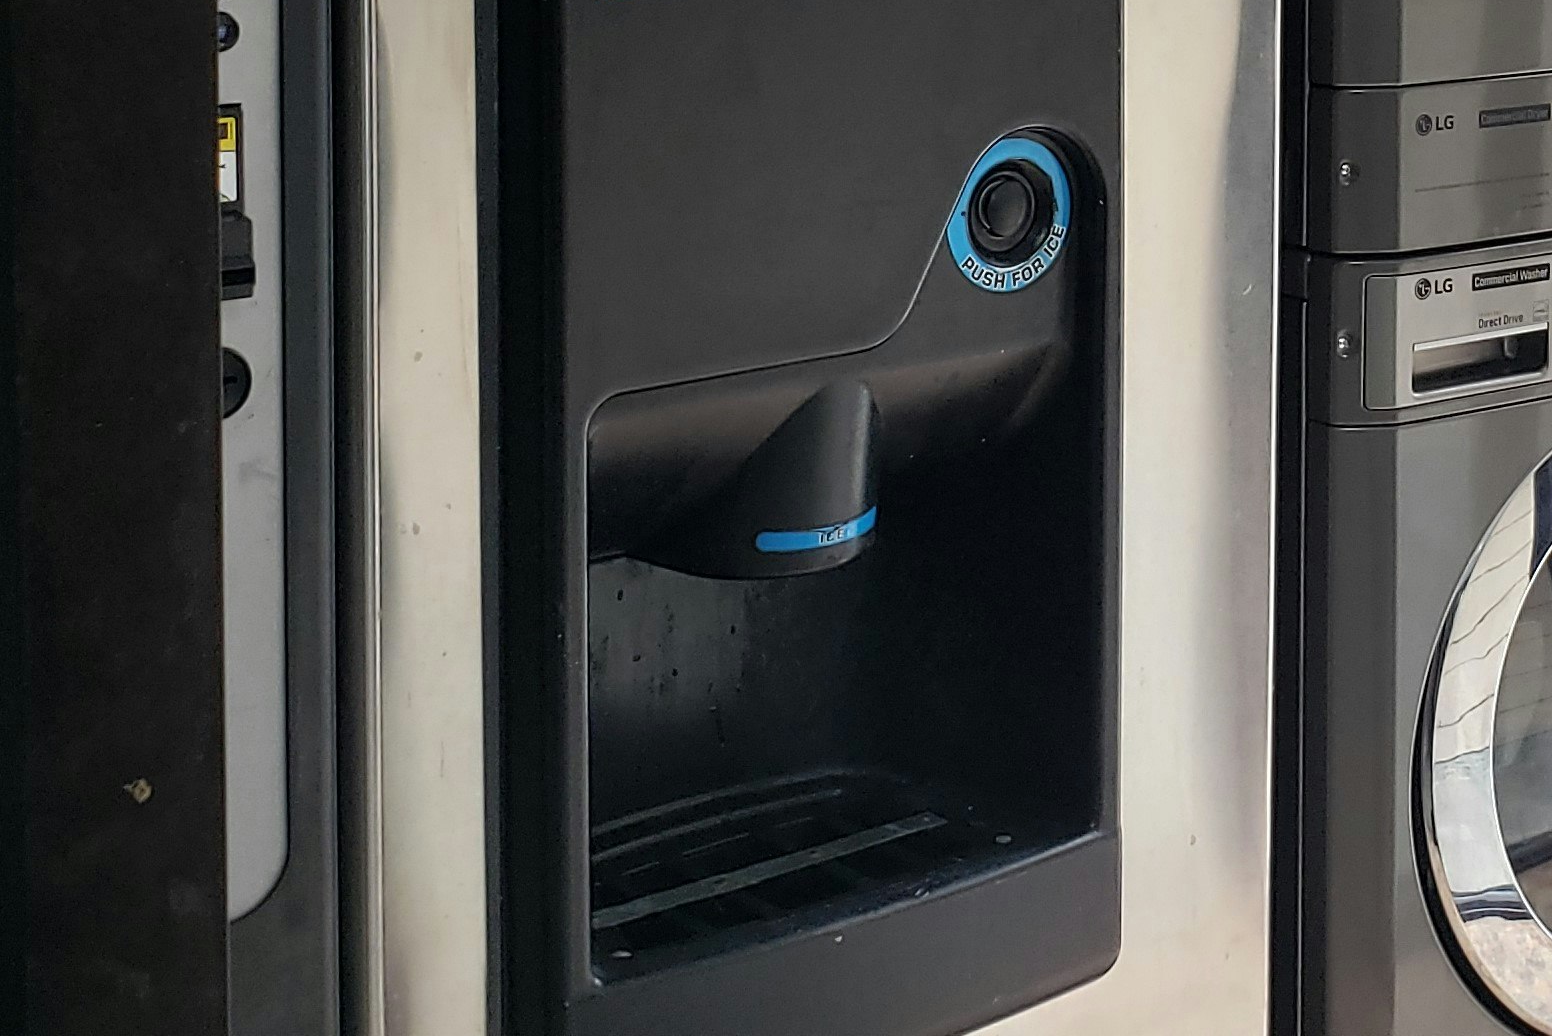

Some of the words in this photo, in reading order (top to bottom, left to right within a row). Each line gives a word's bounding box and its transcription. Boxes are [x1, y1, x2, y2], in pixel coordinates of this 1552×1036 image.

[961, 254, 1006, 289] PUSH
[1011, 257, 1045, 287] FOR
[1043, 224, 1065, 258] ICE
[1474, 272, 1518, 287] Commercial
[1519, 267, 1548, 280] Washer
[1478, 315, 1502, 329] Direct
[1503, 313, 1524, 325] Drive
